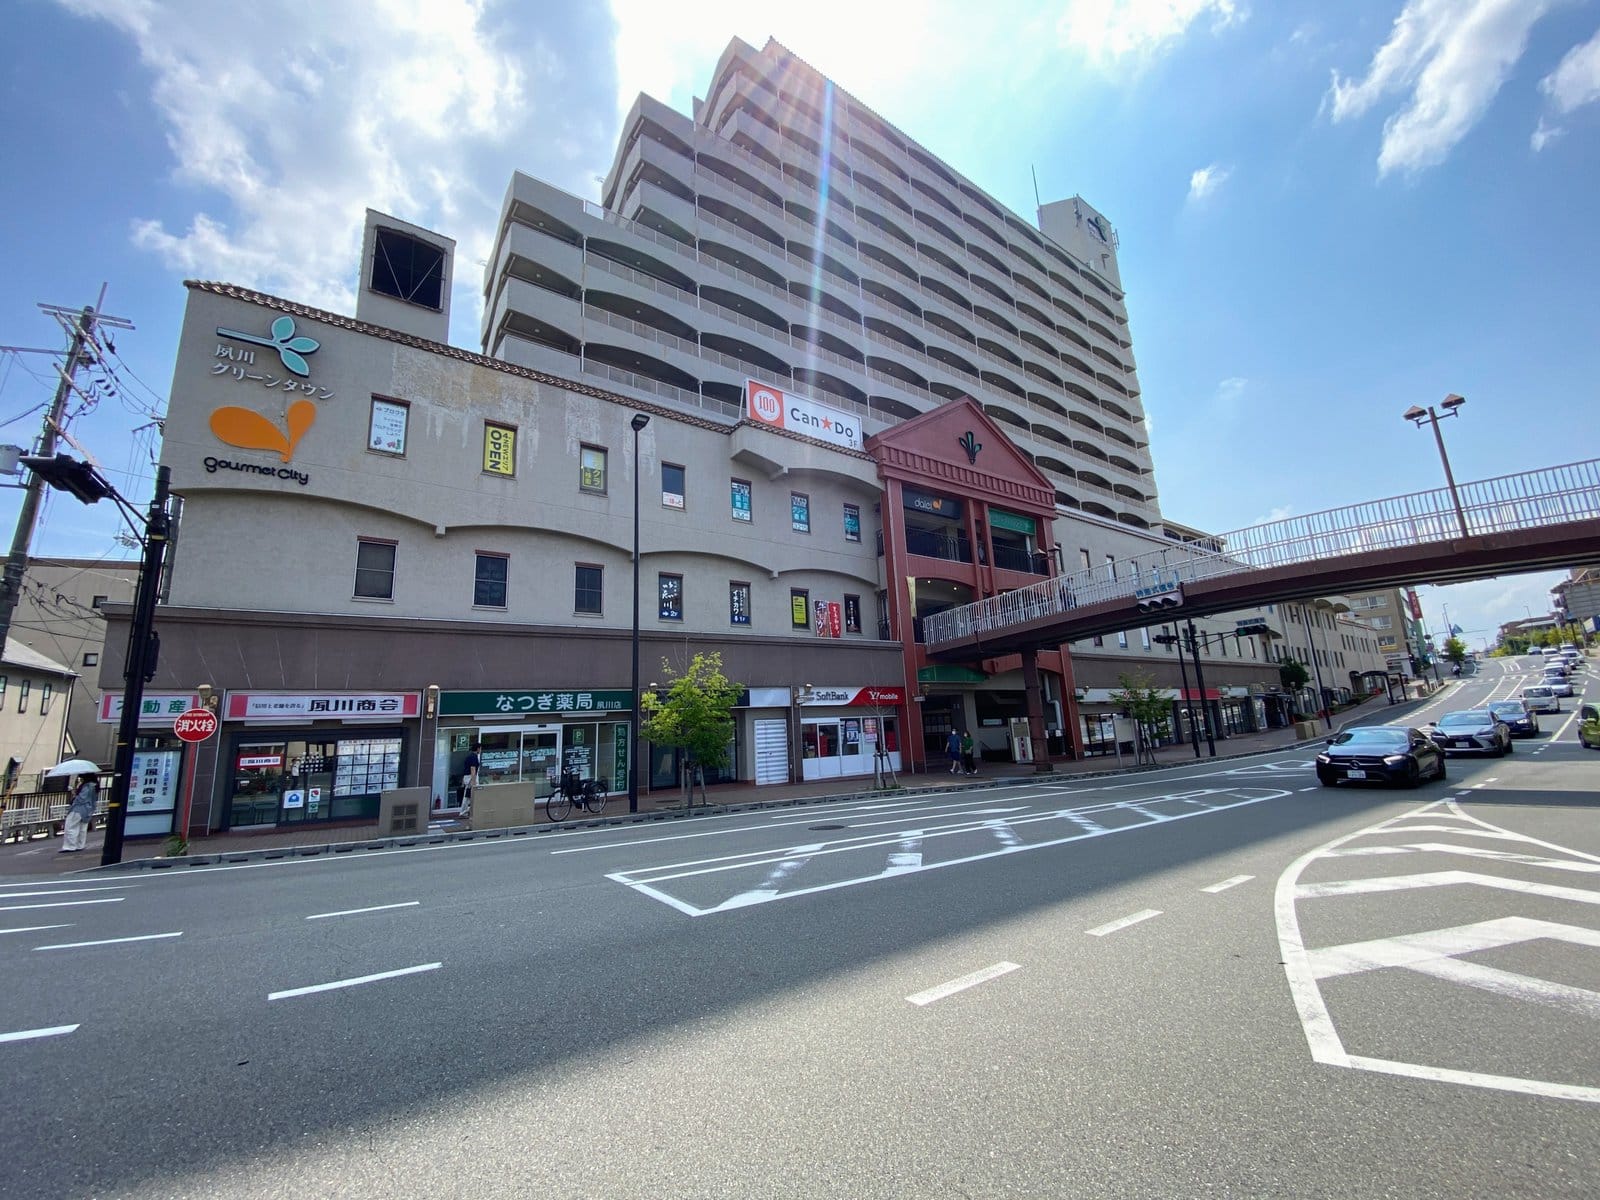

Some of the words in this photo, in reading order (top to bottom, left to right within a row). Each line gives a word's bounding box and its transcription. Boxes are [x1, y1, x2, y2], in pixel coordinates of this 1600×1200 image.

[215, 343, 255, 364] 夙川
[758, 395, 775, 413] 100
[790, 407, 819, 428] Can
[835, 422, 854, 438] Do
[489, 430, 502, 470] OPEN
[203, 456, 276, 477] gourmet
[277, 468, 309, 485] City
[496, 693, 593, 712] なつぎ薬局
[816, 691, 849, 700] SoftBank
[307, 699, 399, 712] 夙川商会
[177, 719, 215, 732] 消火栓
